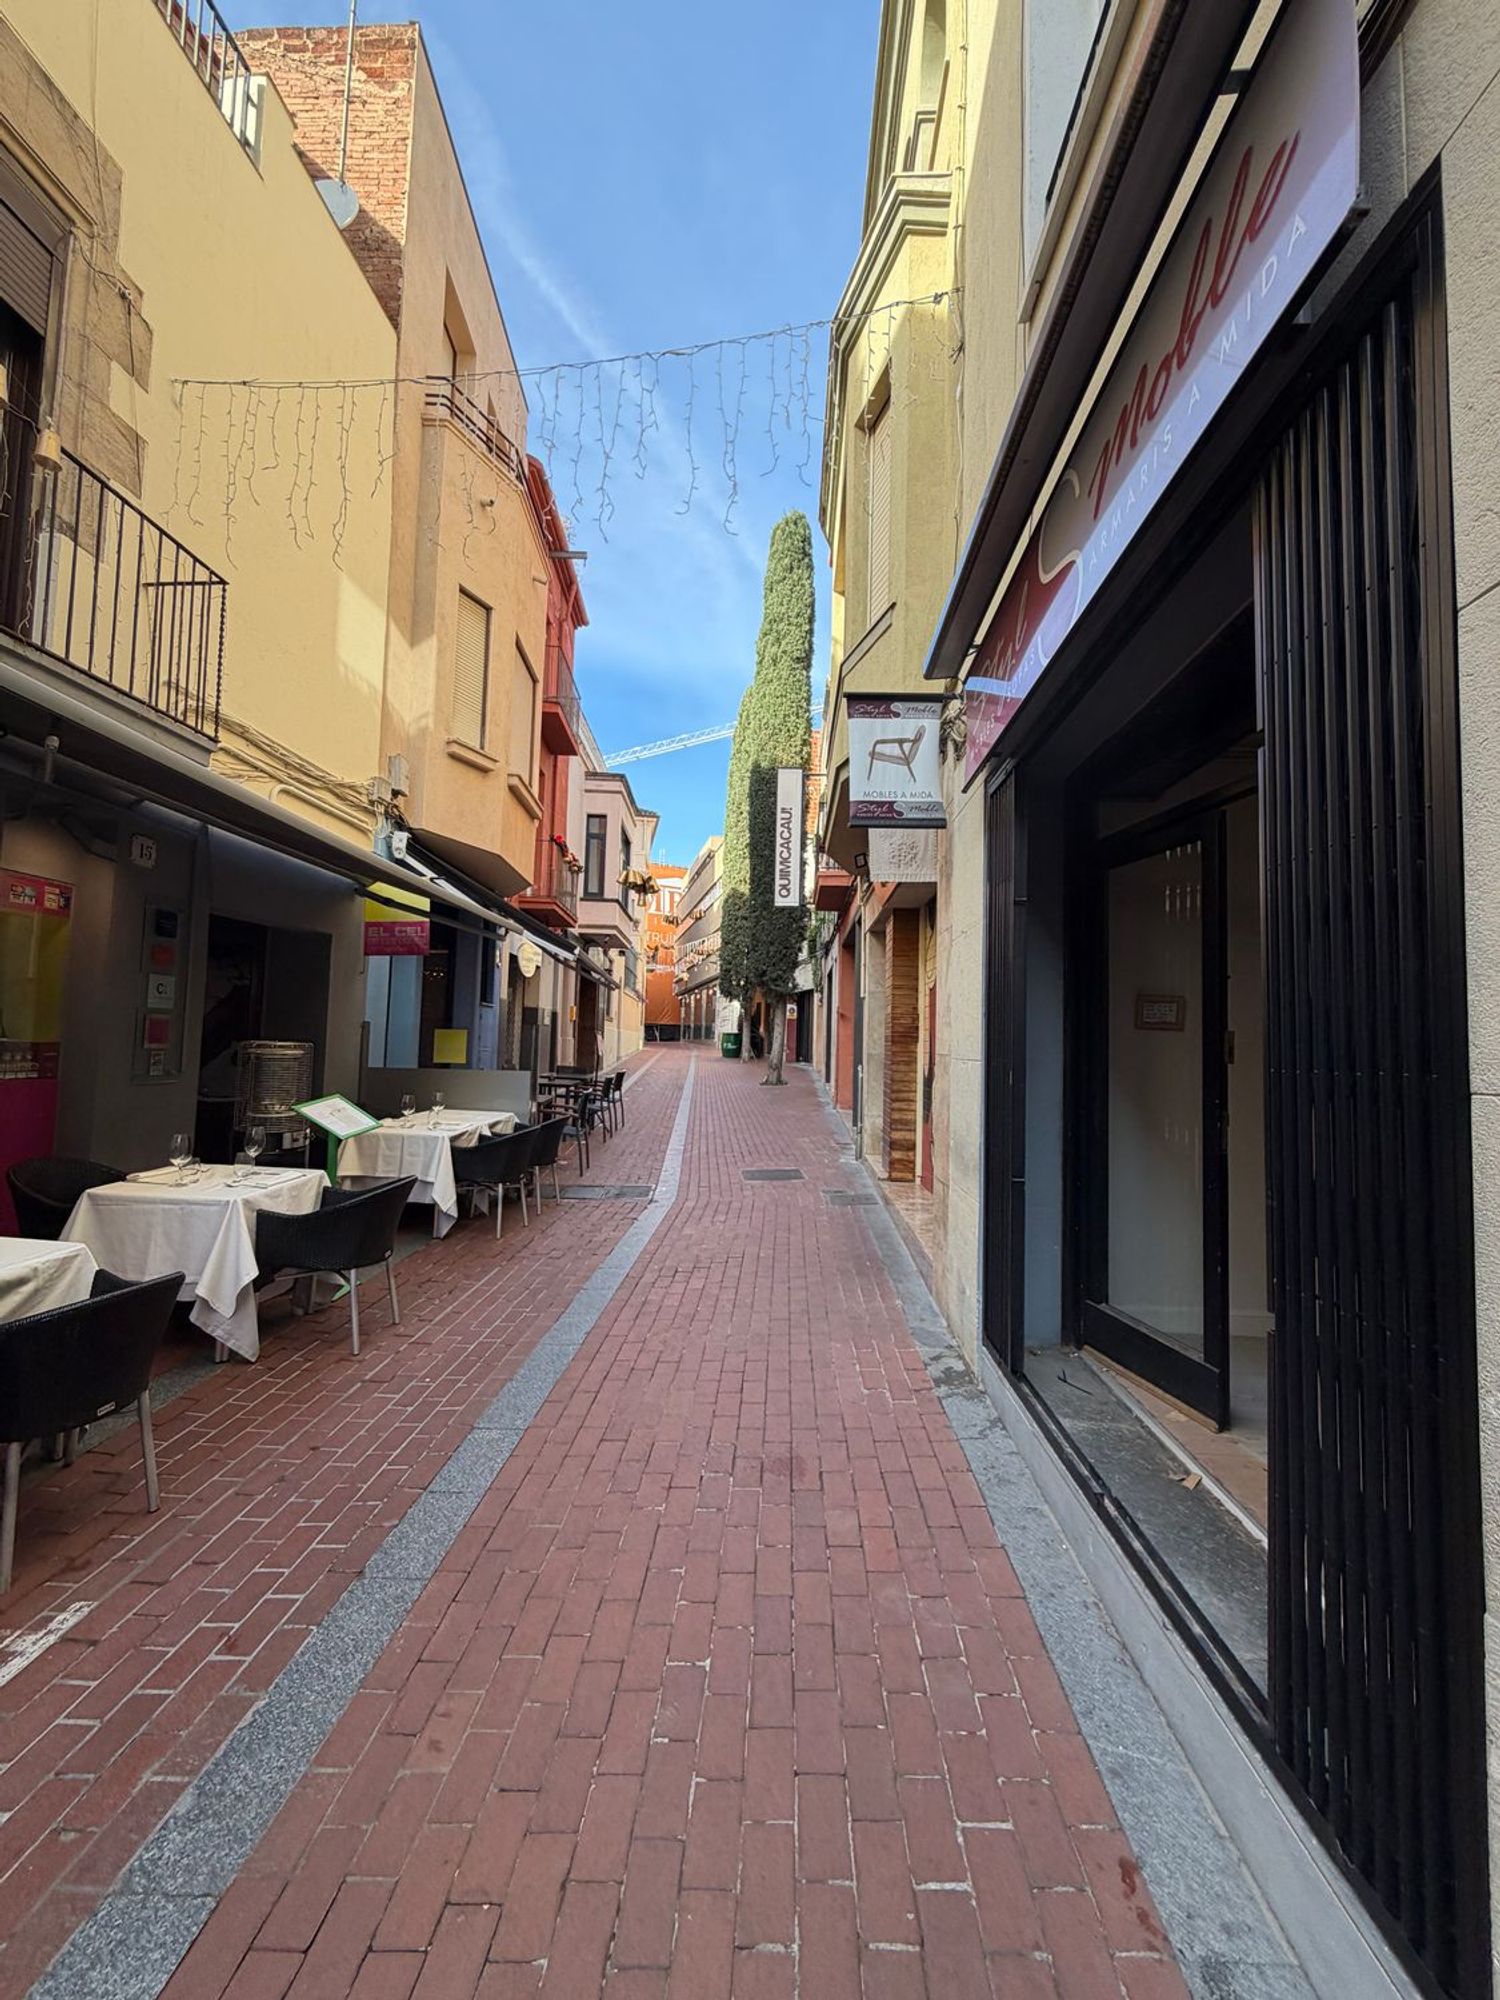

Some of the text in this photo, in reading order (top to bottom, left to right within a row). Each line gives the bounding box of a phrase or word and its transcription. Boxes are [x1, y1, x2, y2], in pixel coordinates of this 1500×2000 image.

[1089, 213, 1307, 570] ARMARIS A MIDA
[862, 790, 934, 799] MOBLES A MIDA
[139, 842, 152, 861] 15
[778, 806, 793, 898] QUIMCACAU!
